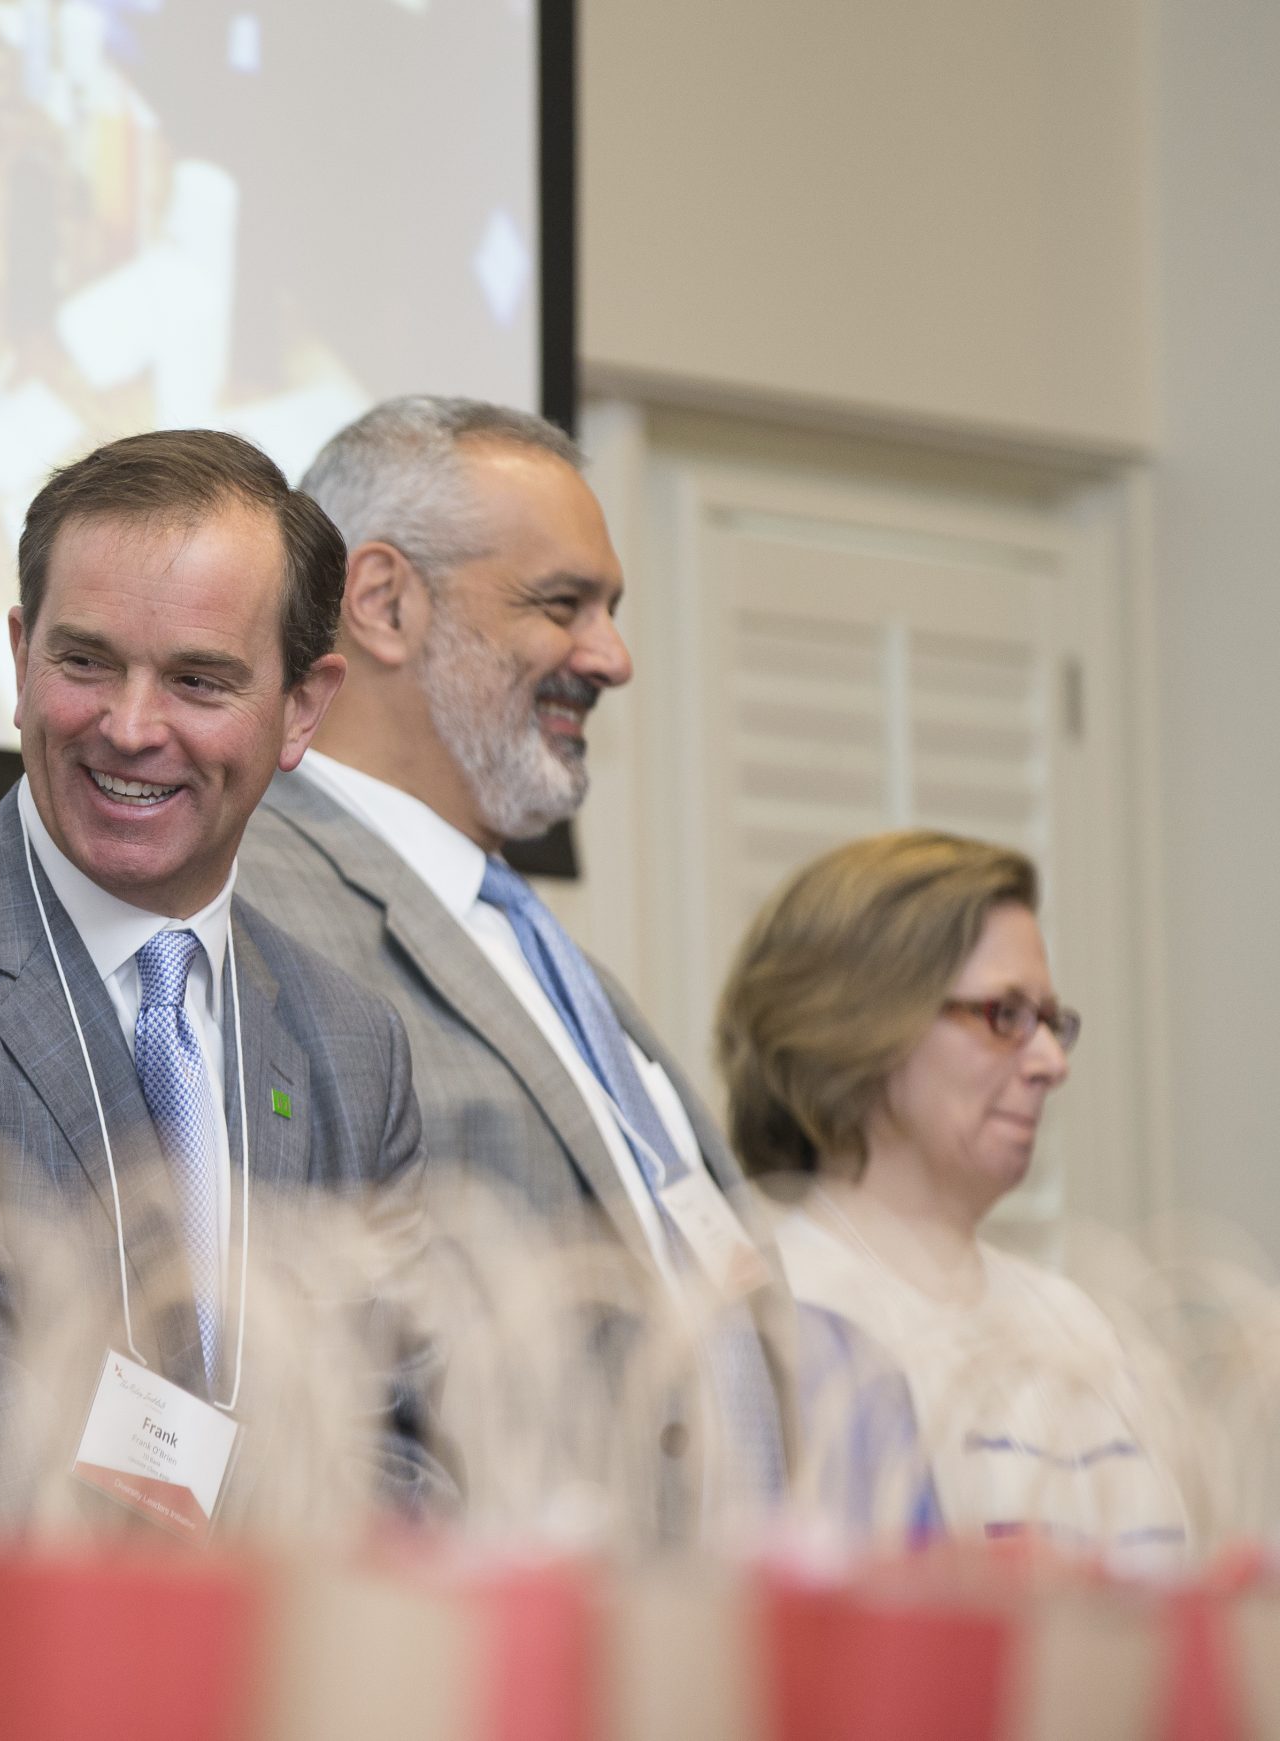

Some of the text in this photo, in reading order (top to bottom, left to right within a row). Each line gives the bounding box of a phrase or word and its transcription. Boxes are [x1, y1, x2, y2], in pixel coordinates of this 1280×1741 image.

[142, 1416, 179, 1449] Frank
[130, 1433, 178, 1467] Frank O'Brien
[114, 1477, 143, 1502] Diversity
[143, 1492, 170, 1518] Leaders
